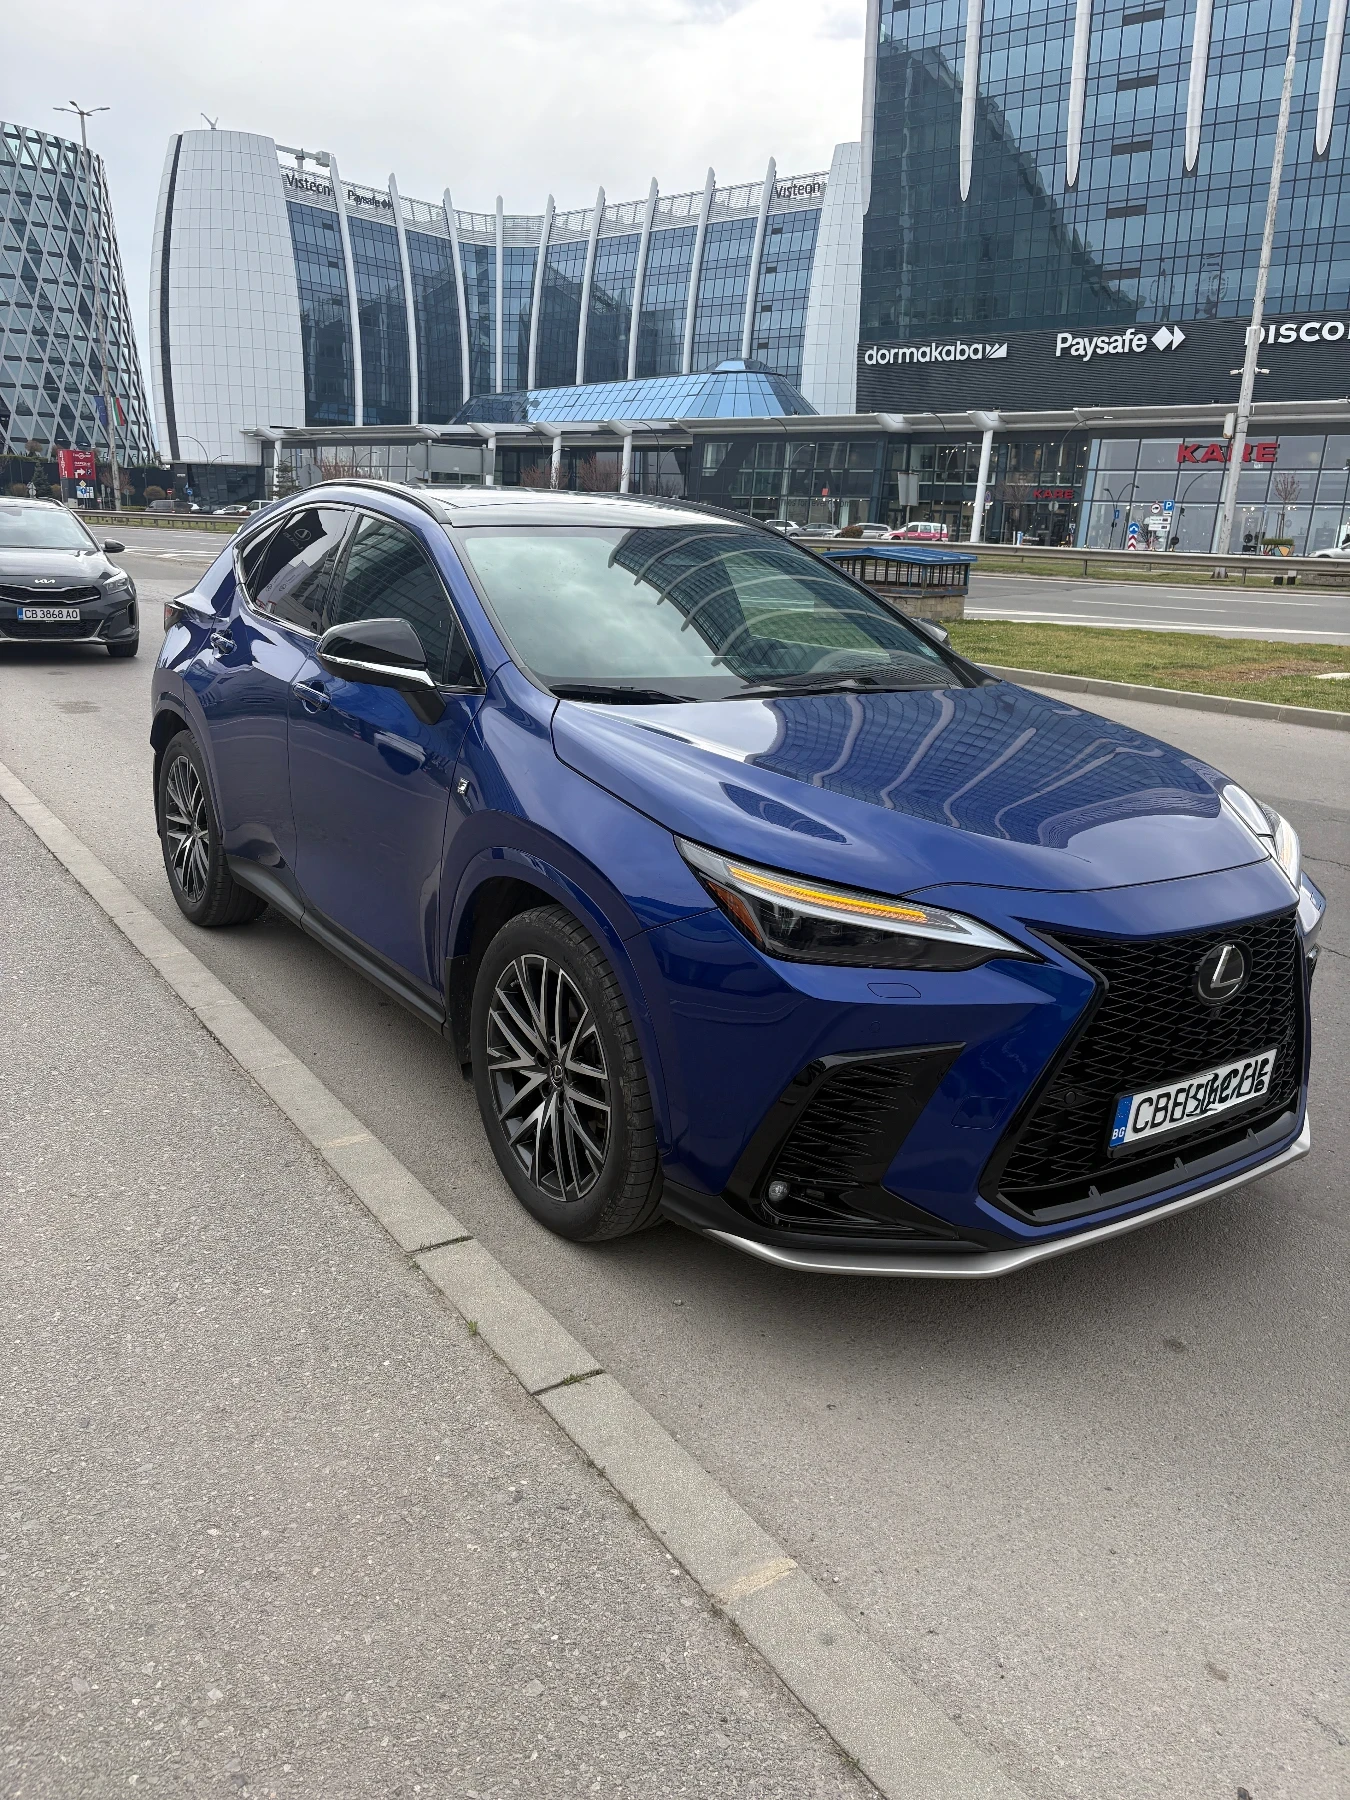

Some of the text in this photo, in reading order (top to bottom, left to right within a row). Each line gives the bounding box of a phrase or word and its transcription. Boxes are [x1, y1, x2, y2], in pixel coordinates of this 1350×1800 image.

[285, 173, 331, 197] Visteon
[776, 182, 821, 199] Visteon
[347, 189, 381, 208] Paysafe
[864, 340, 983, 366] dormakaba
[1054, 327, 1148, 362] Paysafe
[1032, 488, 1074, 499] KARE
[39, 609, 64, 619] 3868
[1112, 1126, 1126, 1140] BG
